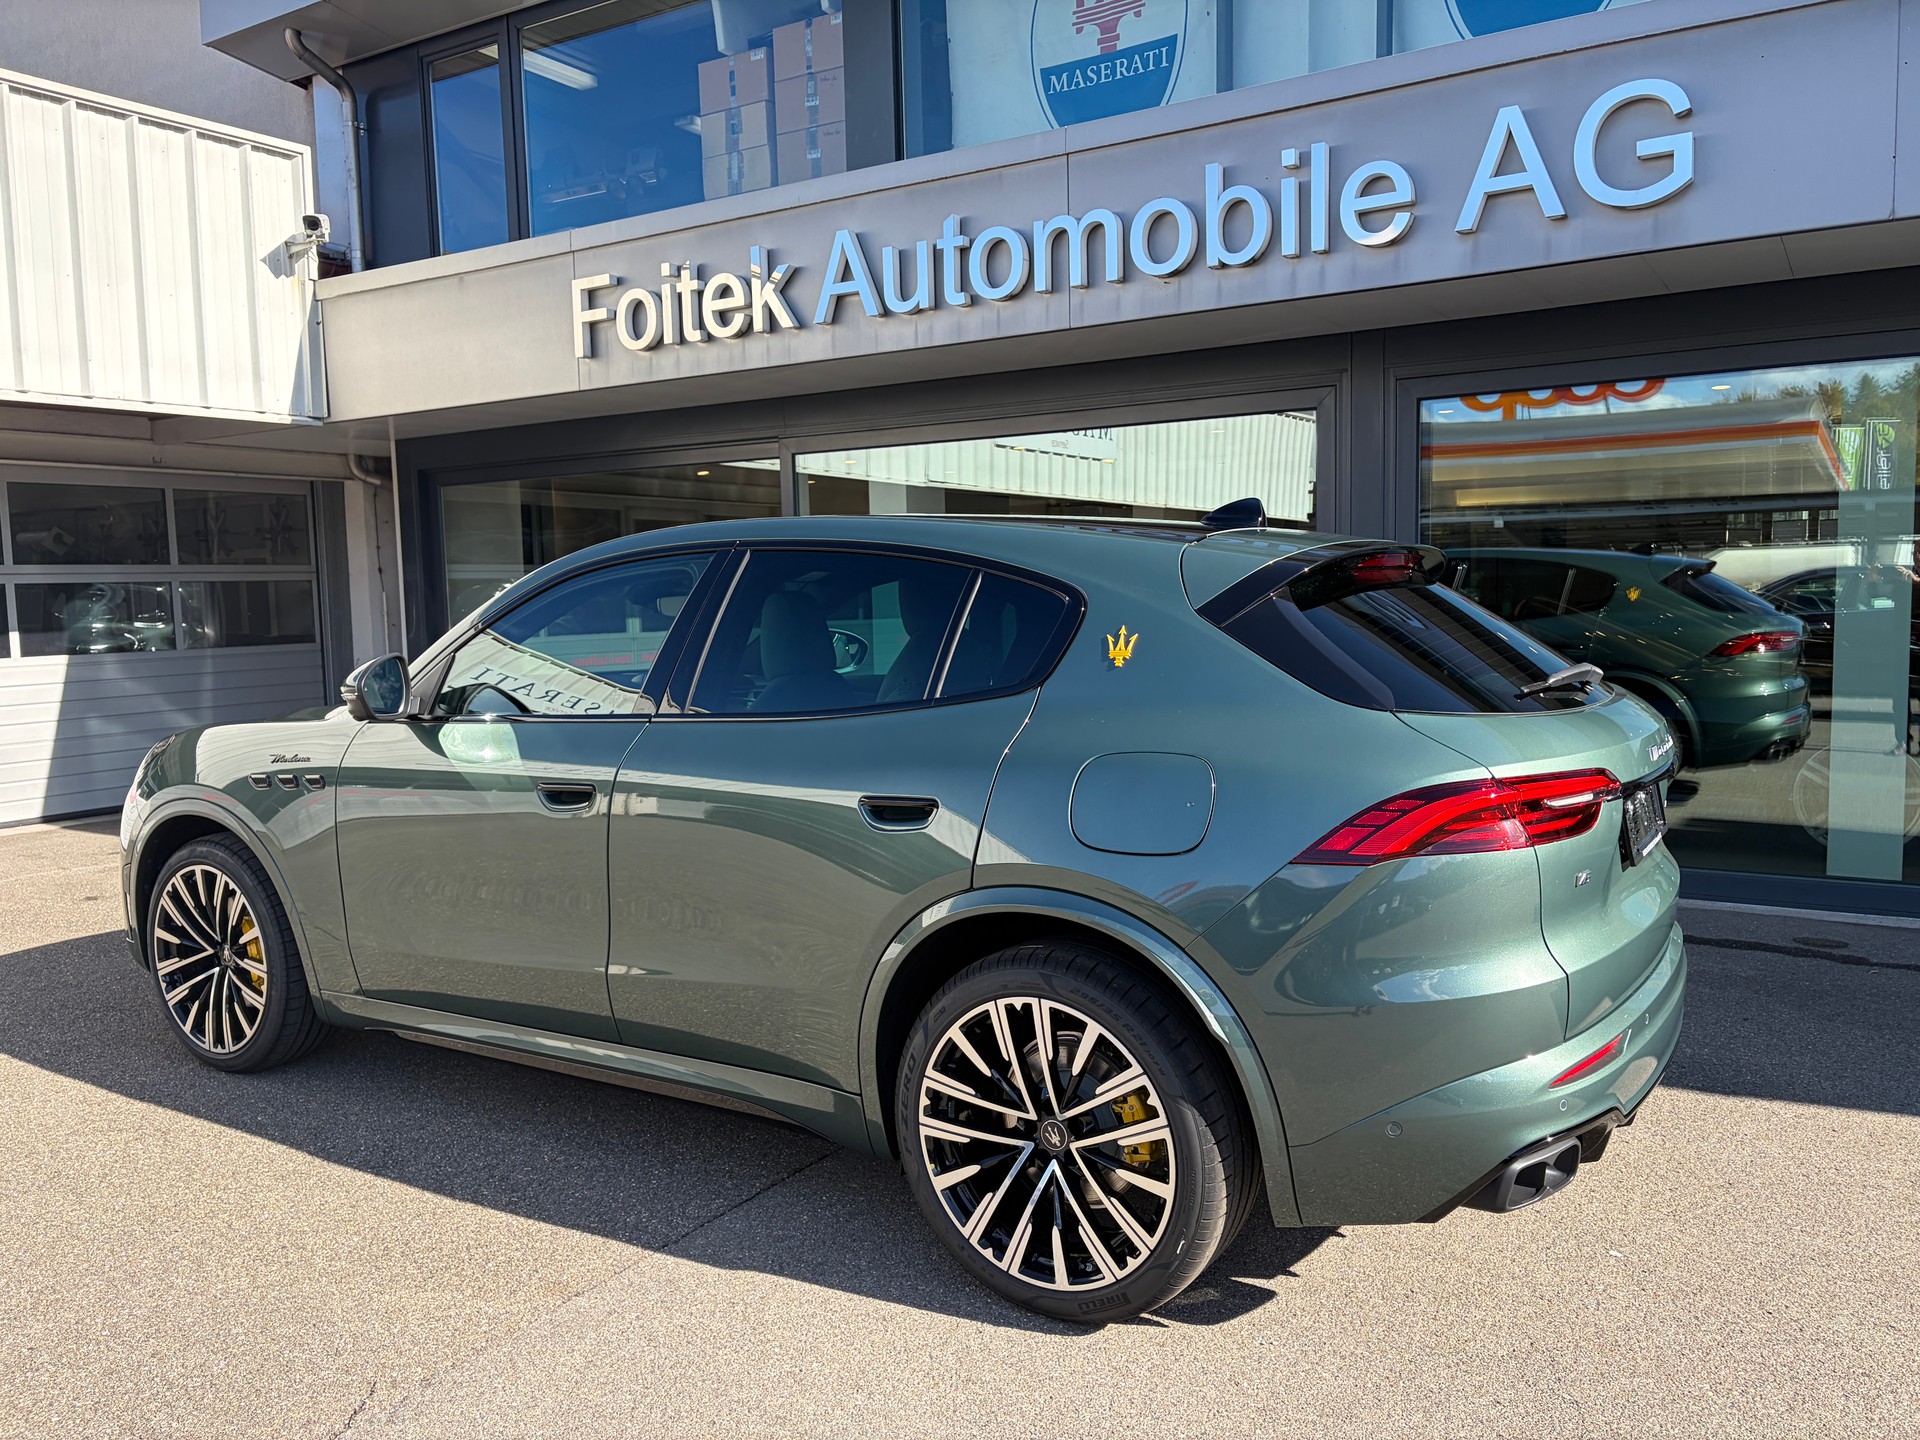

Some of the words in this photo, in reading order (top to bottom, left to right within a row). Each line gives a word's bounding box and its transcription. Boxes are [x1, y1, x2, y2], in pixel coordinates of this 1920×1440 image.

[1047, 46, 1170, 95] MASERATI
[571, 245, 802, 359] Foitek
[812, 140, 1417, 325] Automobile
[1454, 78, 1695, 235] AG
[900, 1051, 917, 1132] ZERO
[1077, 1292, 1132, 1316] PIRELLI
